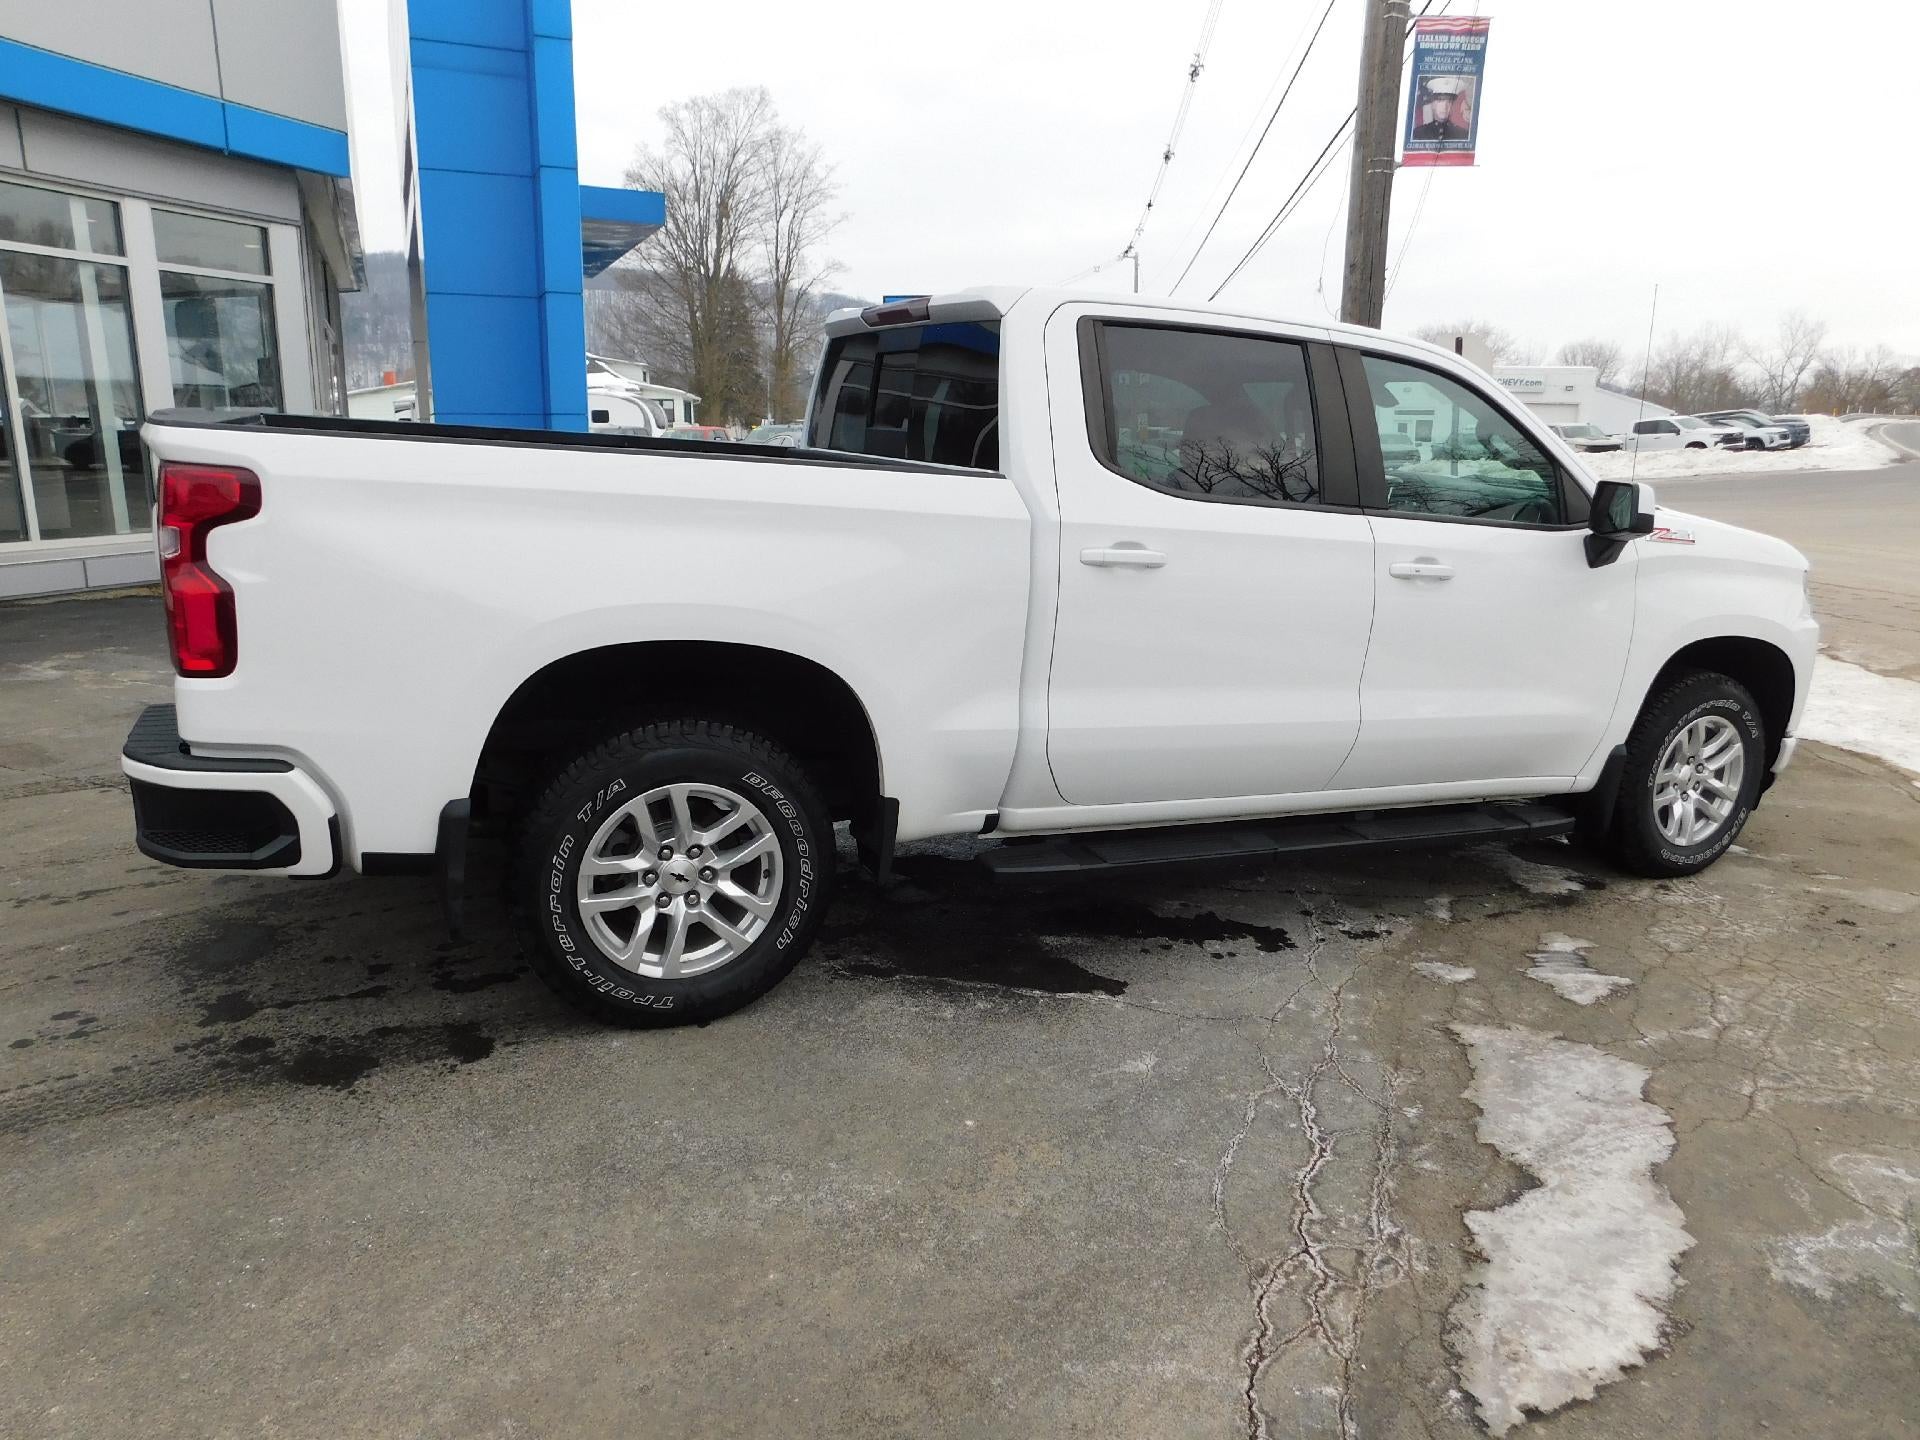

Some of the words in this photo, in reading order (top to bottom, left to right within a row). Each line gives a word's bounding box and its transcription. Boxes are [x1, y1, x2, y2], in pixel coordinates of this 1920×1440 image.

[1419, 42, 1460, 50] HOMETOWN
[1742, 710, 1759, 739] T/A
[577, 778, 627, 823] T/A
[741, 771, 814, 950] BFGoodrich
[1660, 807, 1747, 865] BFGoodrich
[549, 834, 674, 1009] Trail-Terrain
